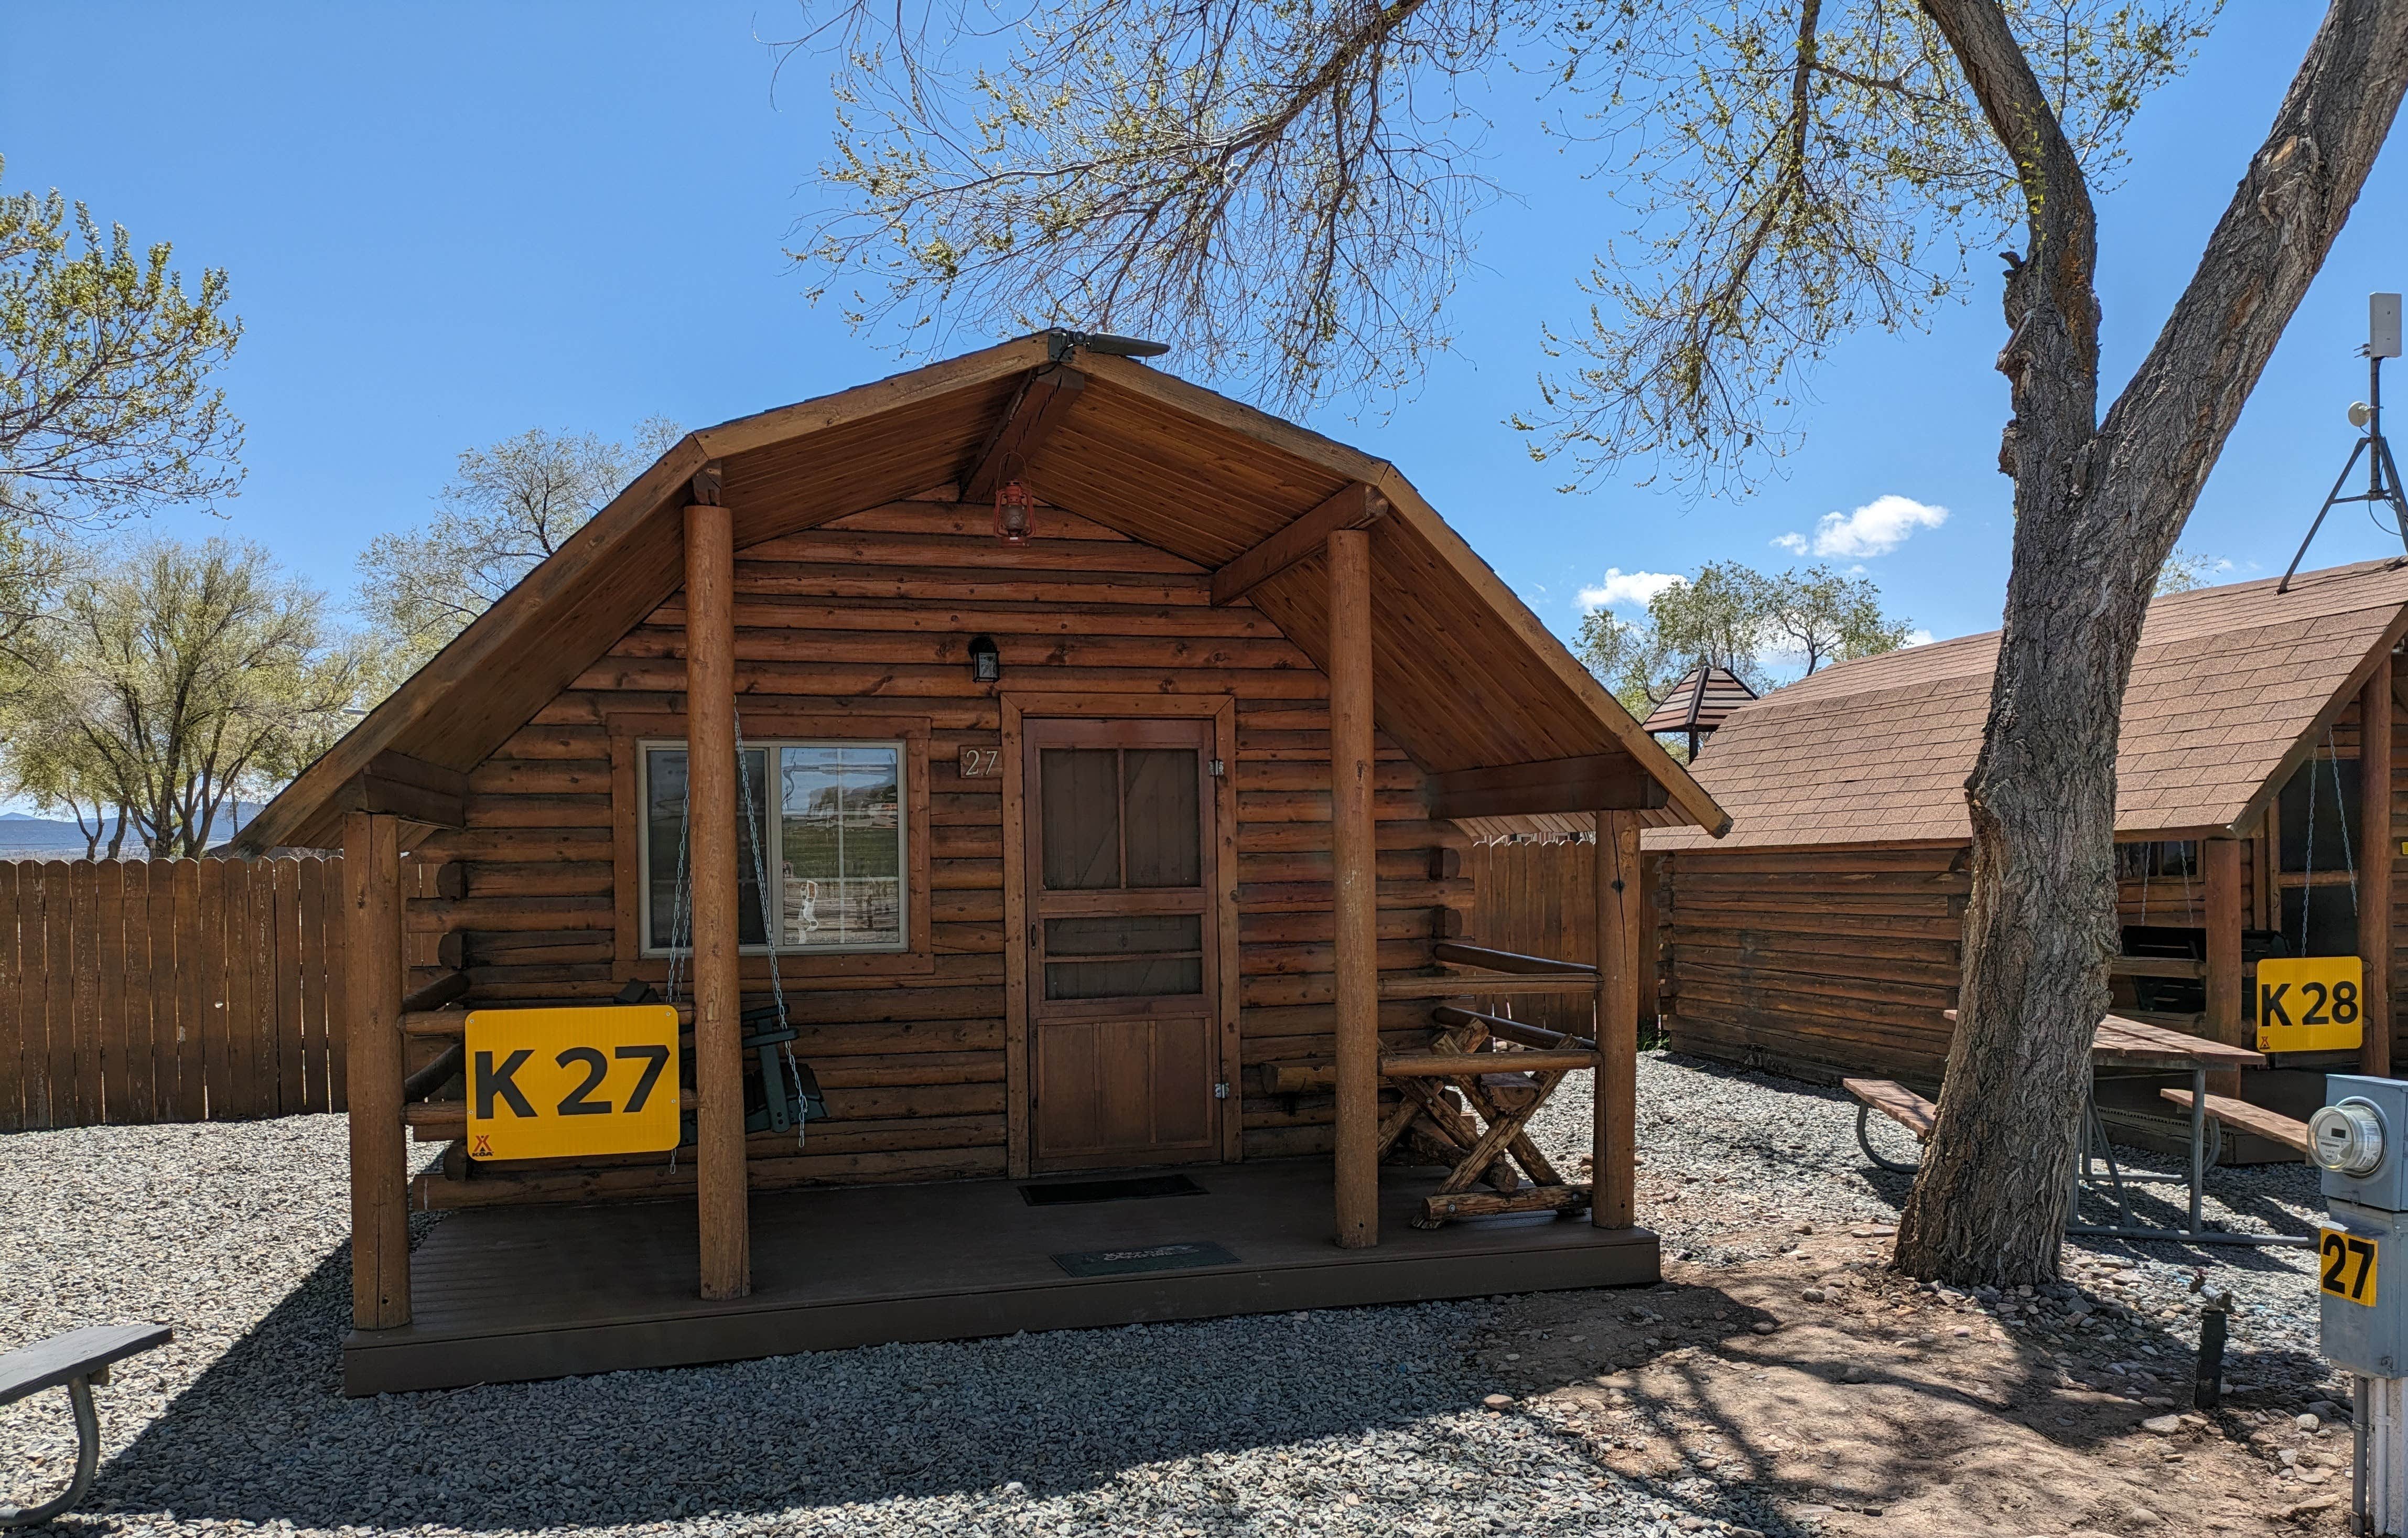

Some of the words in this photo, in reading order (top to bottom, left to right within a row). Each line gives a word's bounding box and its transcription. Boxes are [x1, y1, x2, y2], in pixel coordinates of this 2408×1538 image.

[966, 750, 998, 776] 27
[2261, 983, 2293, 1026] K
[2302, 981, 2358, 1025] 28
[475, 1050, 538, 1120] K
[555, 1045, 670, 1116] 27
[2323, 1233, 2374, 1299] 27
